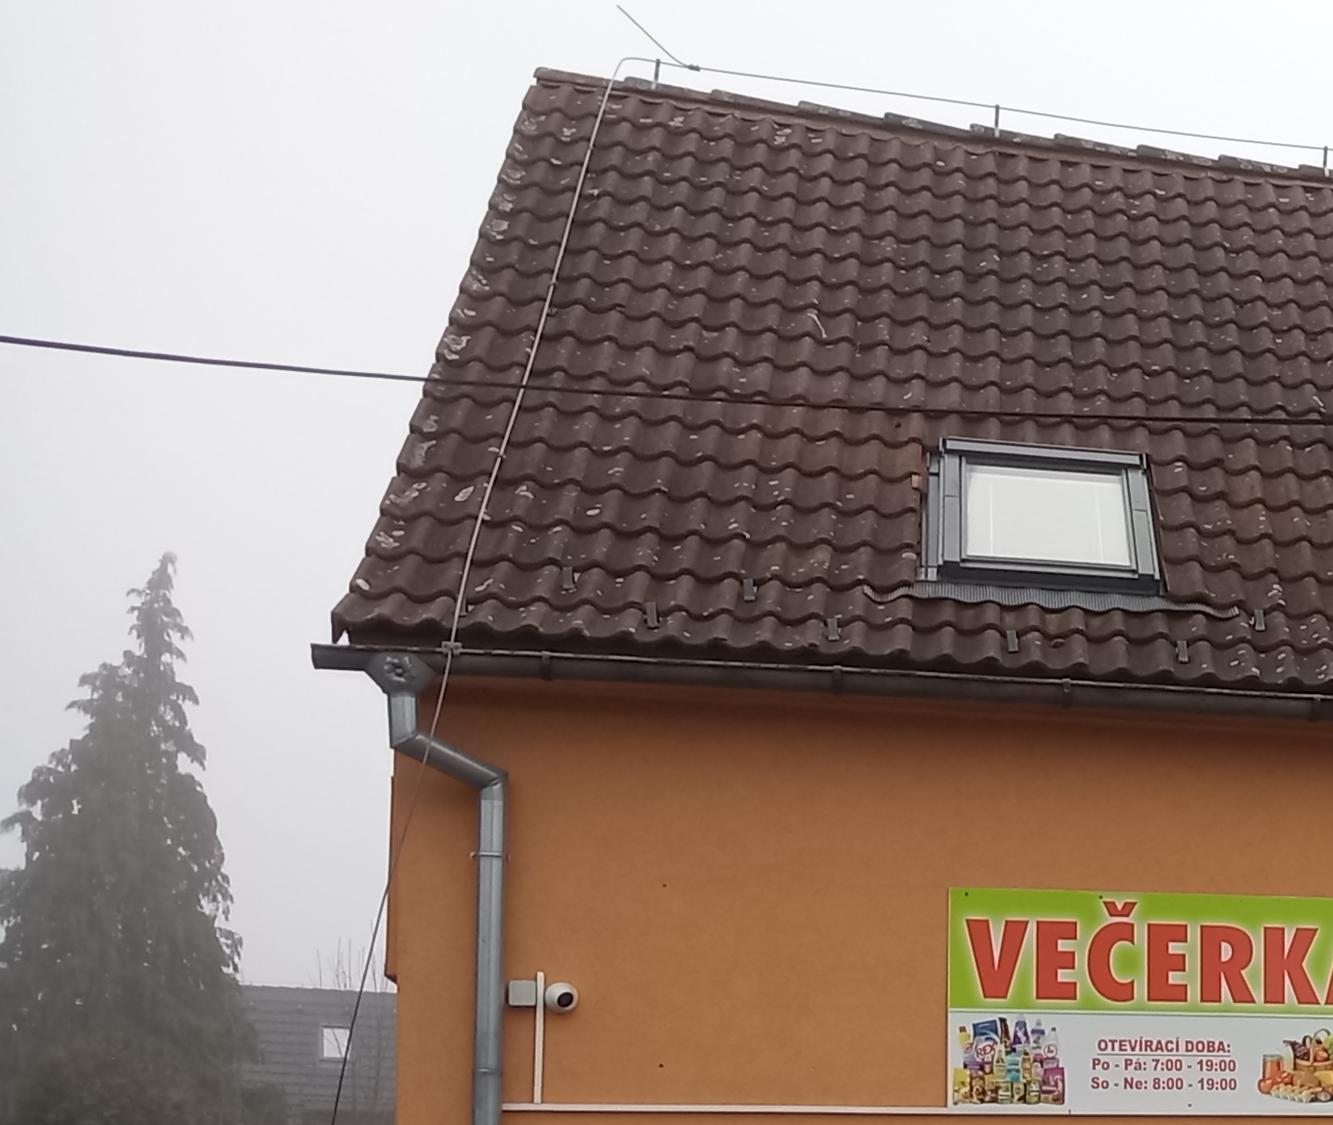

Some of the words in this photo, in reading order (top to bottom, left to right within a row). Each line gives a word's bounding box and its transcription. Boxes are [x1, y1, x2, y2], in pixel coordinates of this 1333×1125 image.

[1097, 1036, 1180, 1052] OTEVÍRACÍ
[1185, 1040, 1231, 1053] DOBA:
[1092, 1058, 1110, 1071] Po
[1124, 1058, 1147, 1071] Pá:
[1152, 1058, 1183, 1071] 7:00
[1197, 1059, 1236, 1072] 19:00
[1091, 1076, 1109, 1089] So
[1124, 1077, 1148, 1090] Ne:
[1152, 1077, 1183, 1090] 8:00
[1197, 1078, 1237, 1090] 19:00
